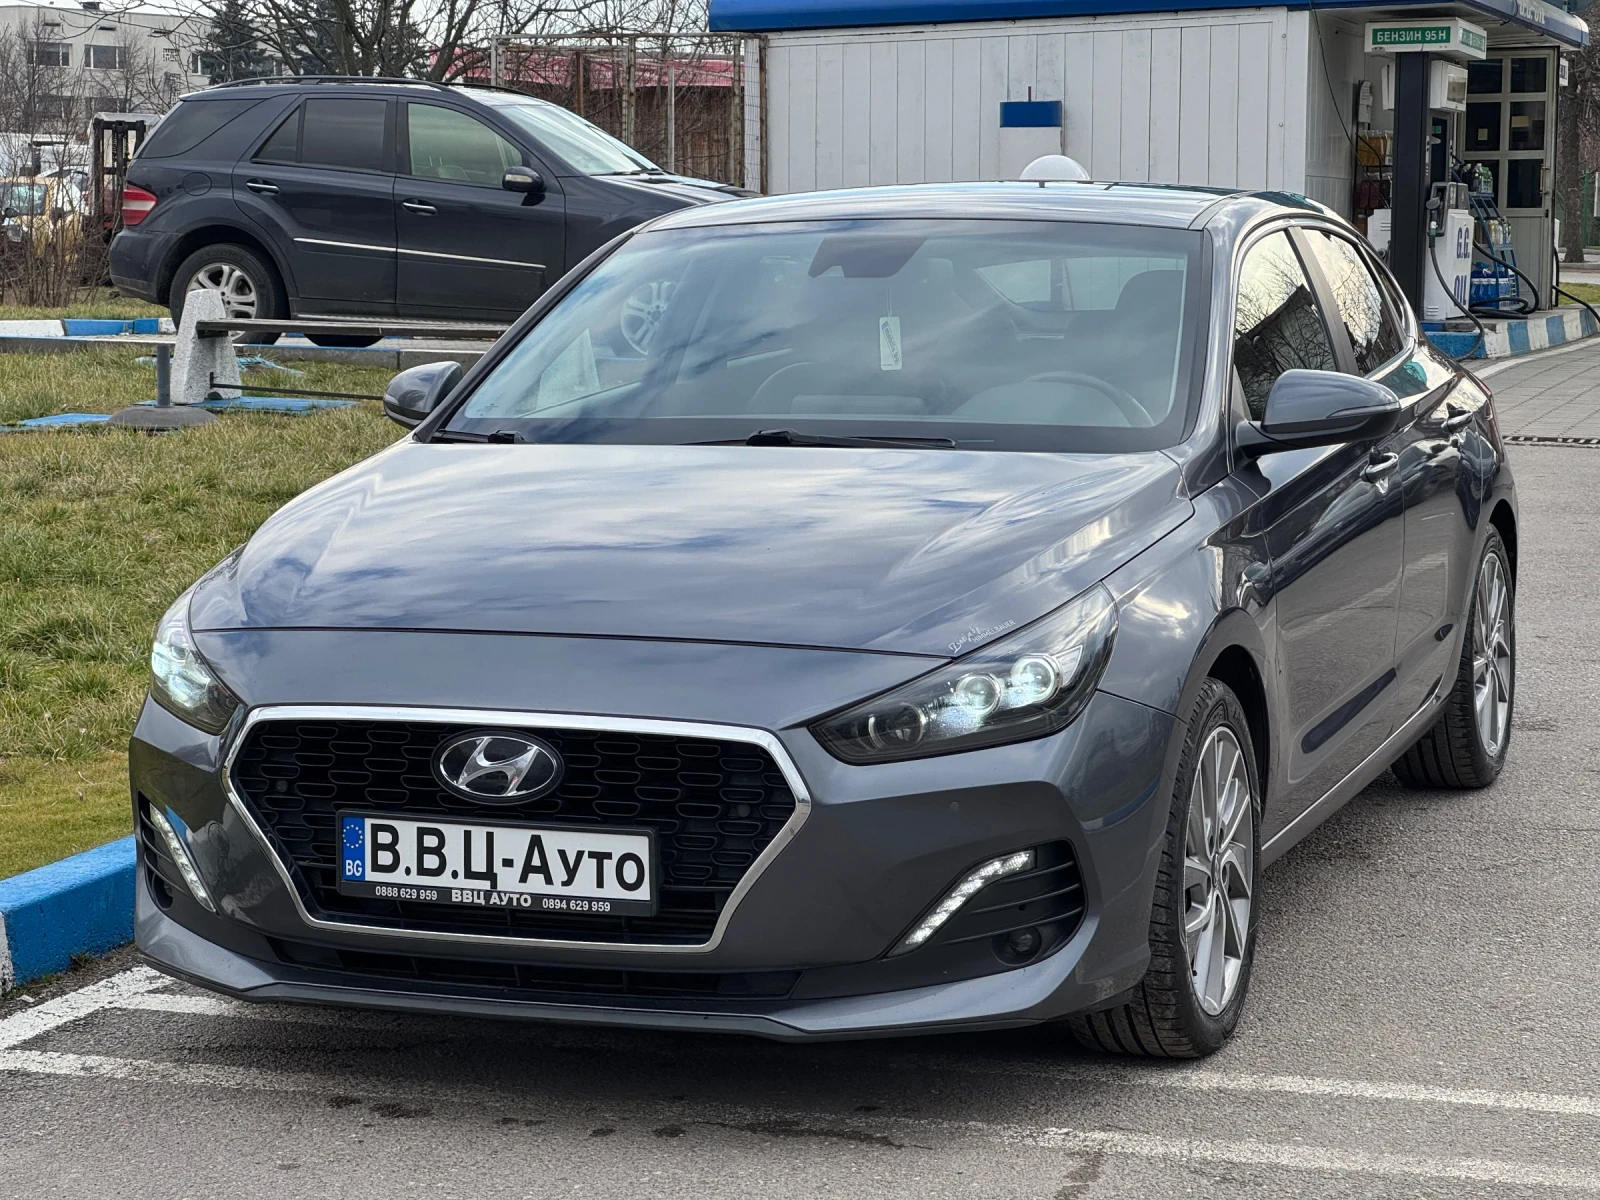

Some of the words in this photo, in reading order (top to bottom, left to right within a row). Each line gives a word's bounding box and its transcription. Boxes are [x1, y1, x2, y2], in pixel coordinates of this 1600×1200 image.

[1376, 31, 1422, 43] БЕНЗИН
[972, 619, 1017, 643] HIMMELBAUER
[345, 859, 363, 876] BG
[370, 823, 646, 892] В.В.Ц-Ауто
[375, 885, 399, 897] 0888
[400, 888, 418, 899] 629
[419, 889, 438, 900] 959
[451, 889, 486, 906] ВВЦ
[489, 892, 532, 907] АУТО
[542, 898, 568, 910] 0894
[569, 900, 589, 911] 629
[591, 901, 611, 912] 959
